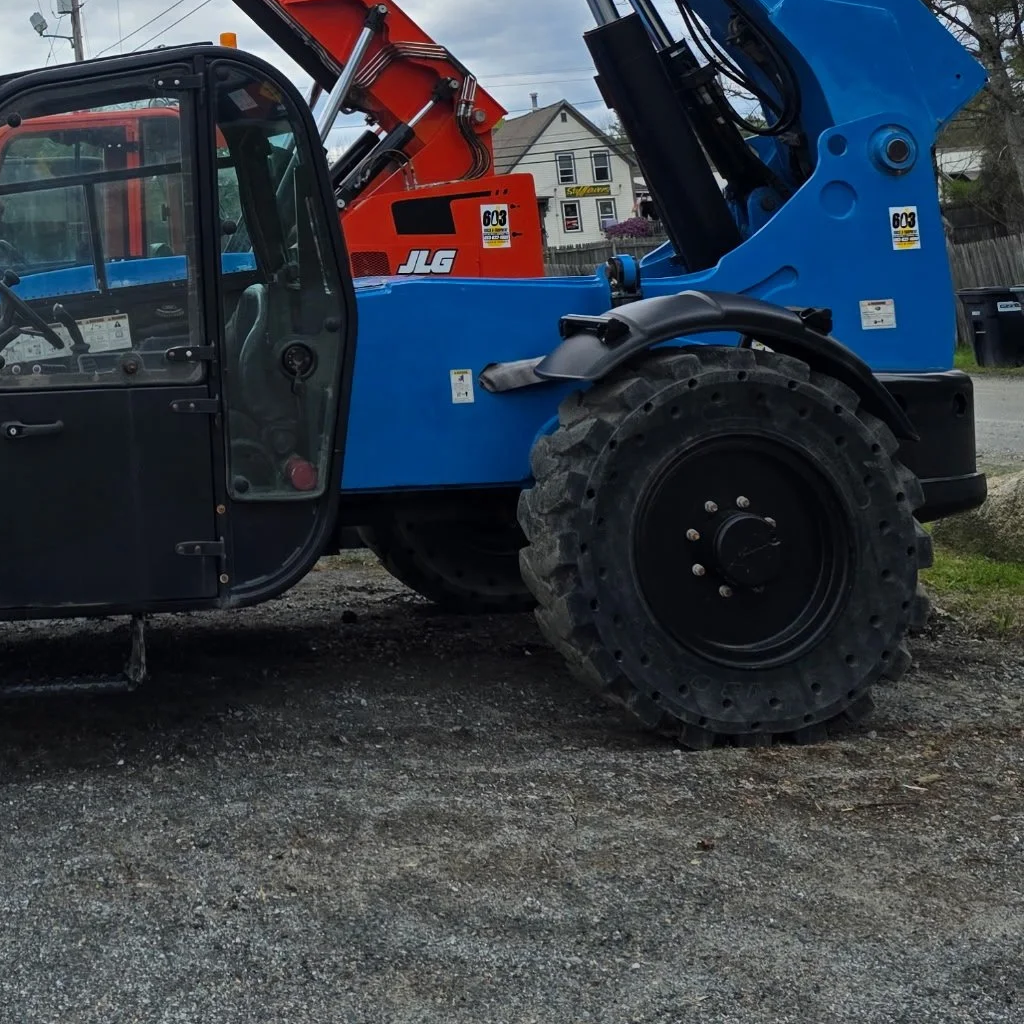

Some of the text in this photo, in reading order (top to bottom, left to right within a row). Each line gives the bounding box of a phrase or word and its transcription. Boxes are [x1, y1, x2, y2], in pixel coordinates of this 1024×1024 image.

[482, 209, 508, 227] 603
[892, 212, 917, 229] 603
[396, 248, 458, 275] JLG
